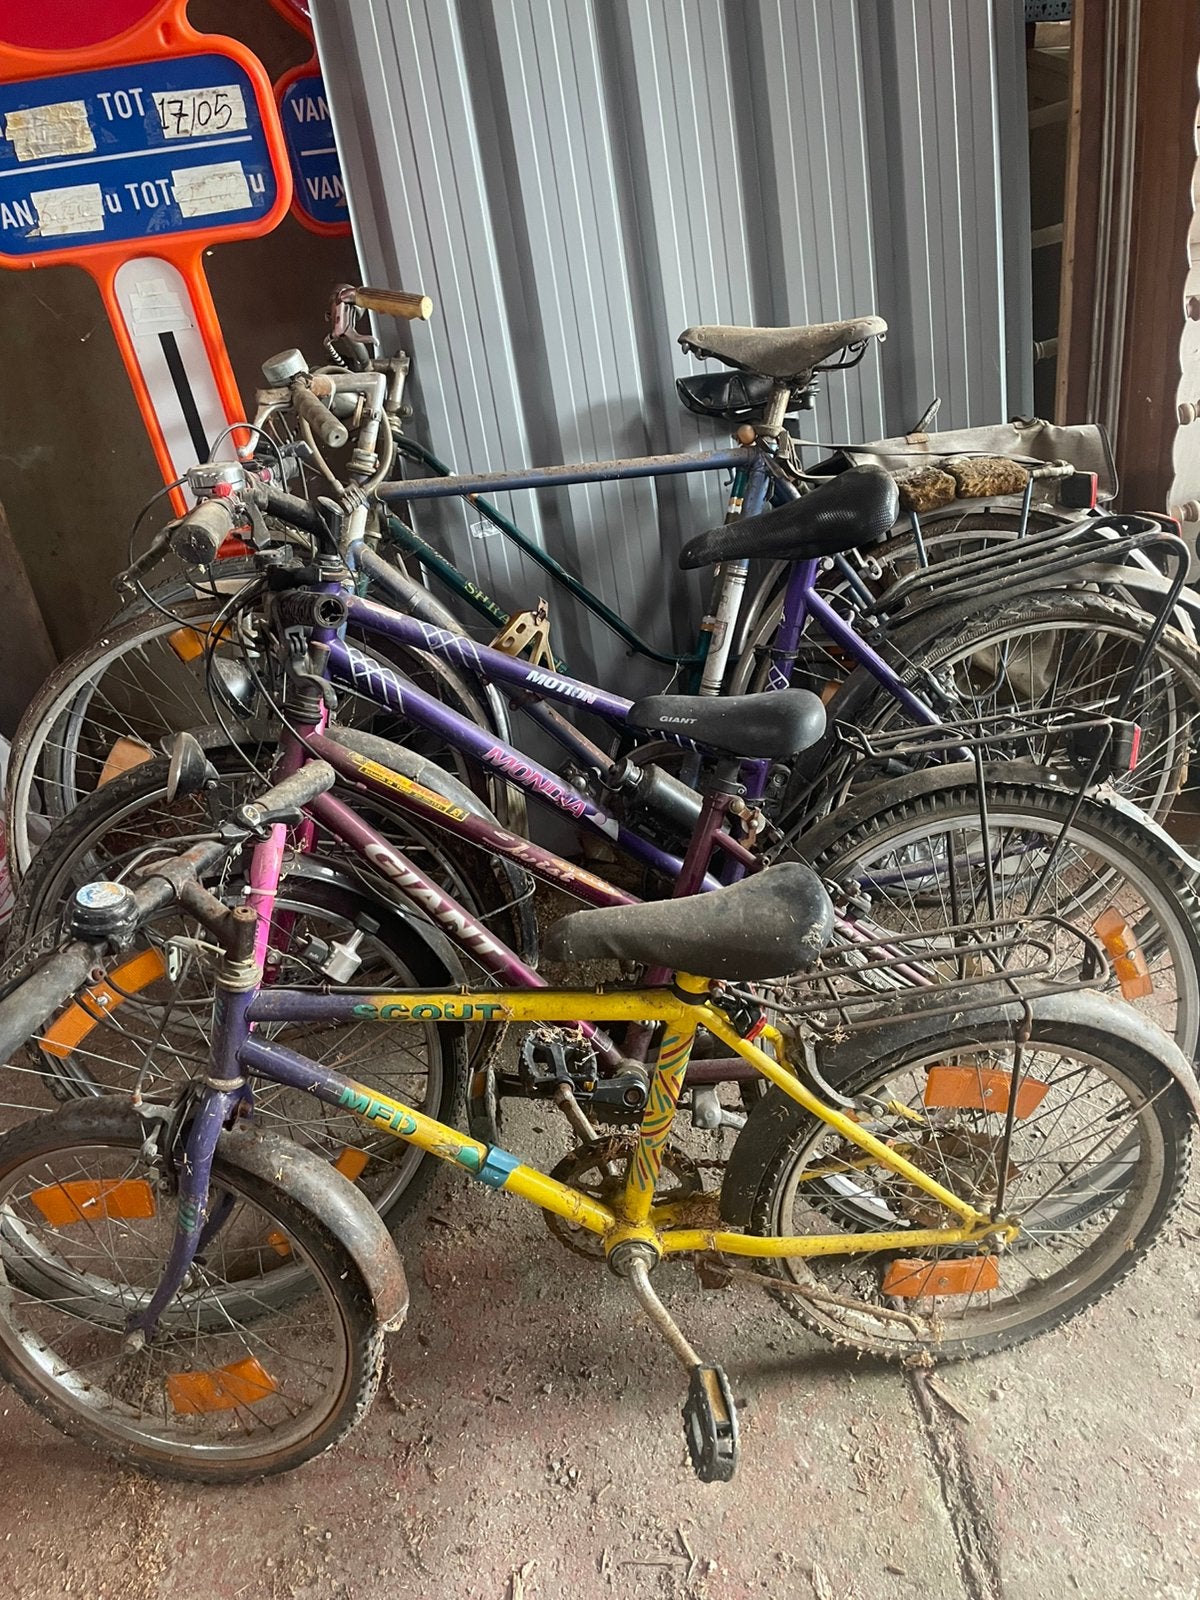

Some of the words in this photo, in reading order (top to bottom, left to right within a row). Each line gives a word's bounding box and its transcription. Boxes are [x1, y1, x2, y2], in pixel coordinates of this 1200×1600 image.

[96, 87, 146, 121] TOT
[158, 94, 233, 137] 17/05
[124, 178, 171, 210] TOT
[525, 669, 599, 705] MOTION
[659, 715, 699, 725] GIANT
[365, 843, 506, 955] GIANT
[352, 1003, 504, 1021] SCOUT
